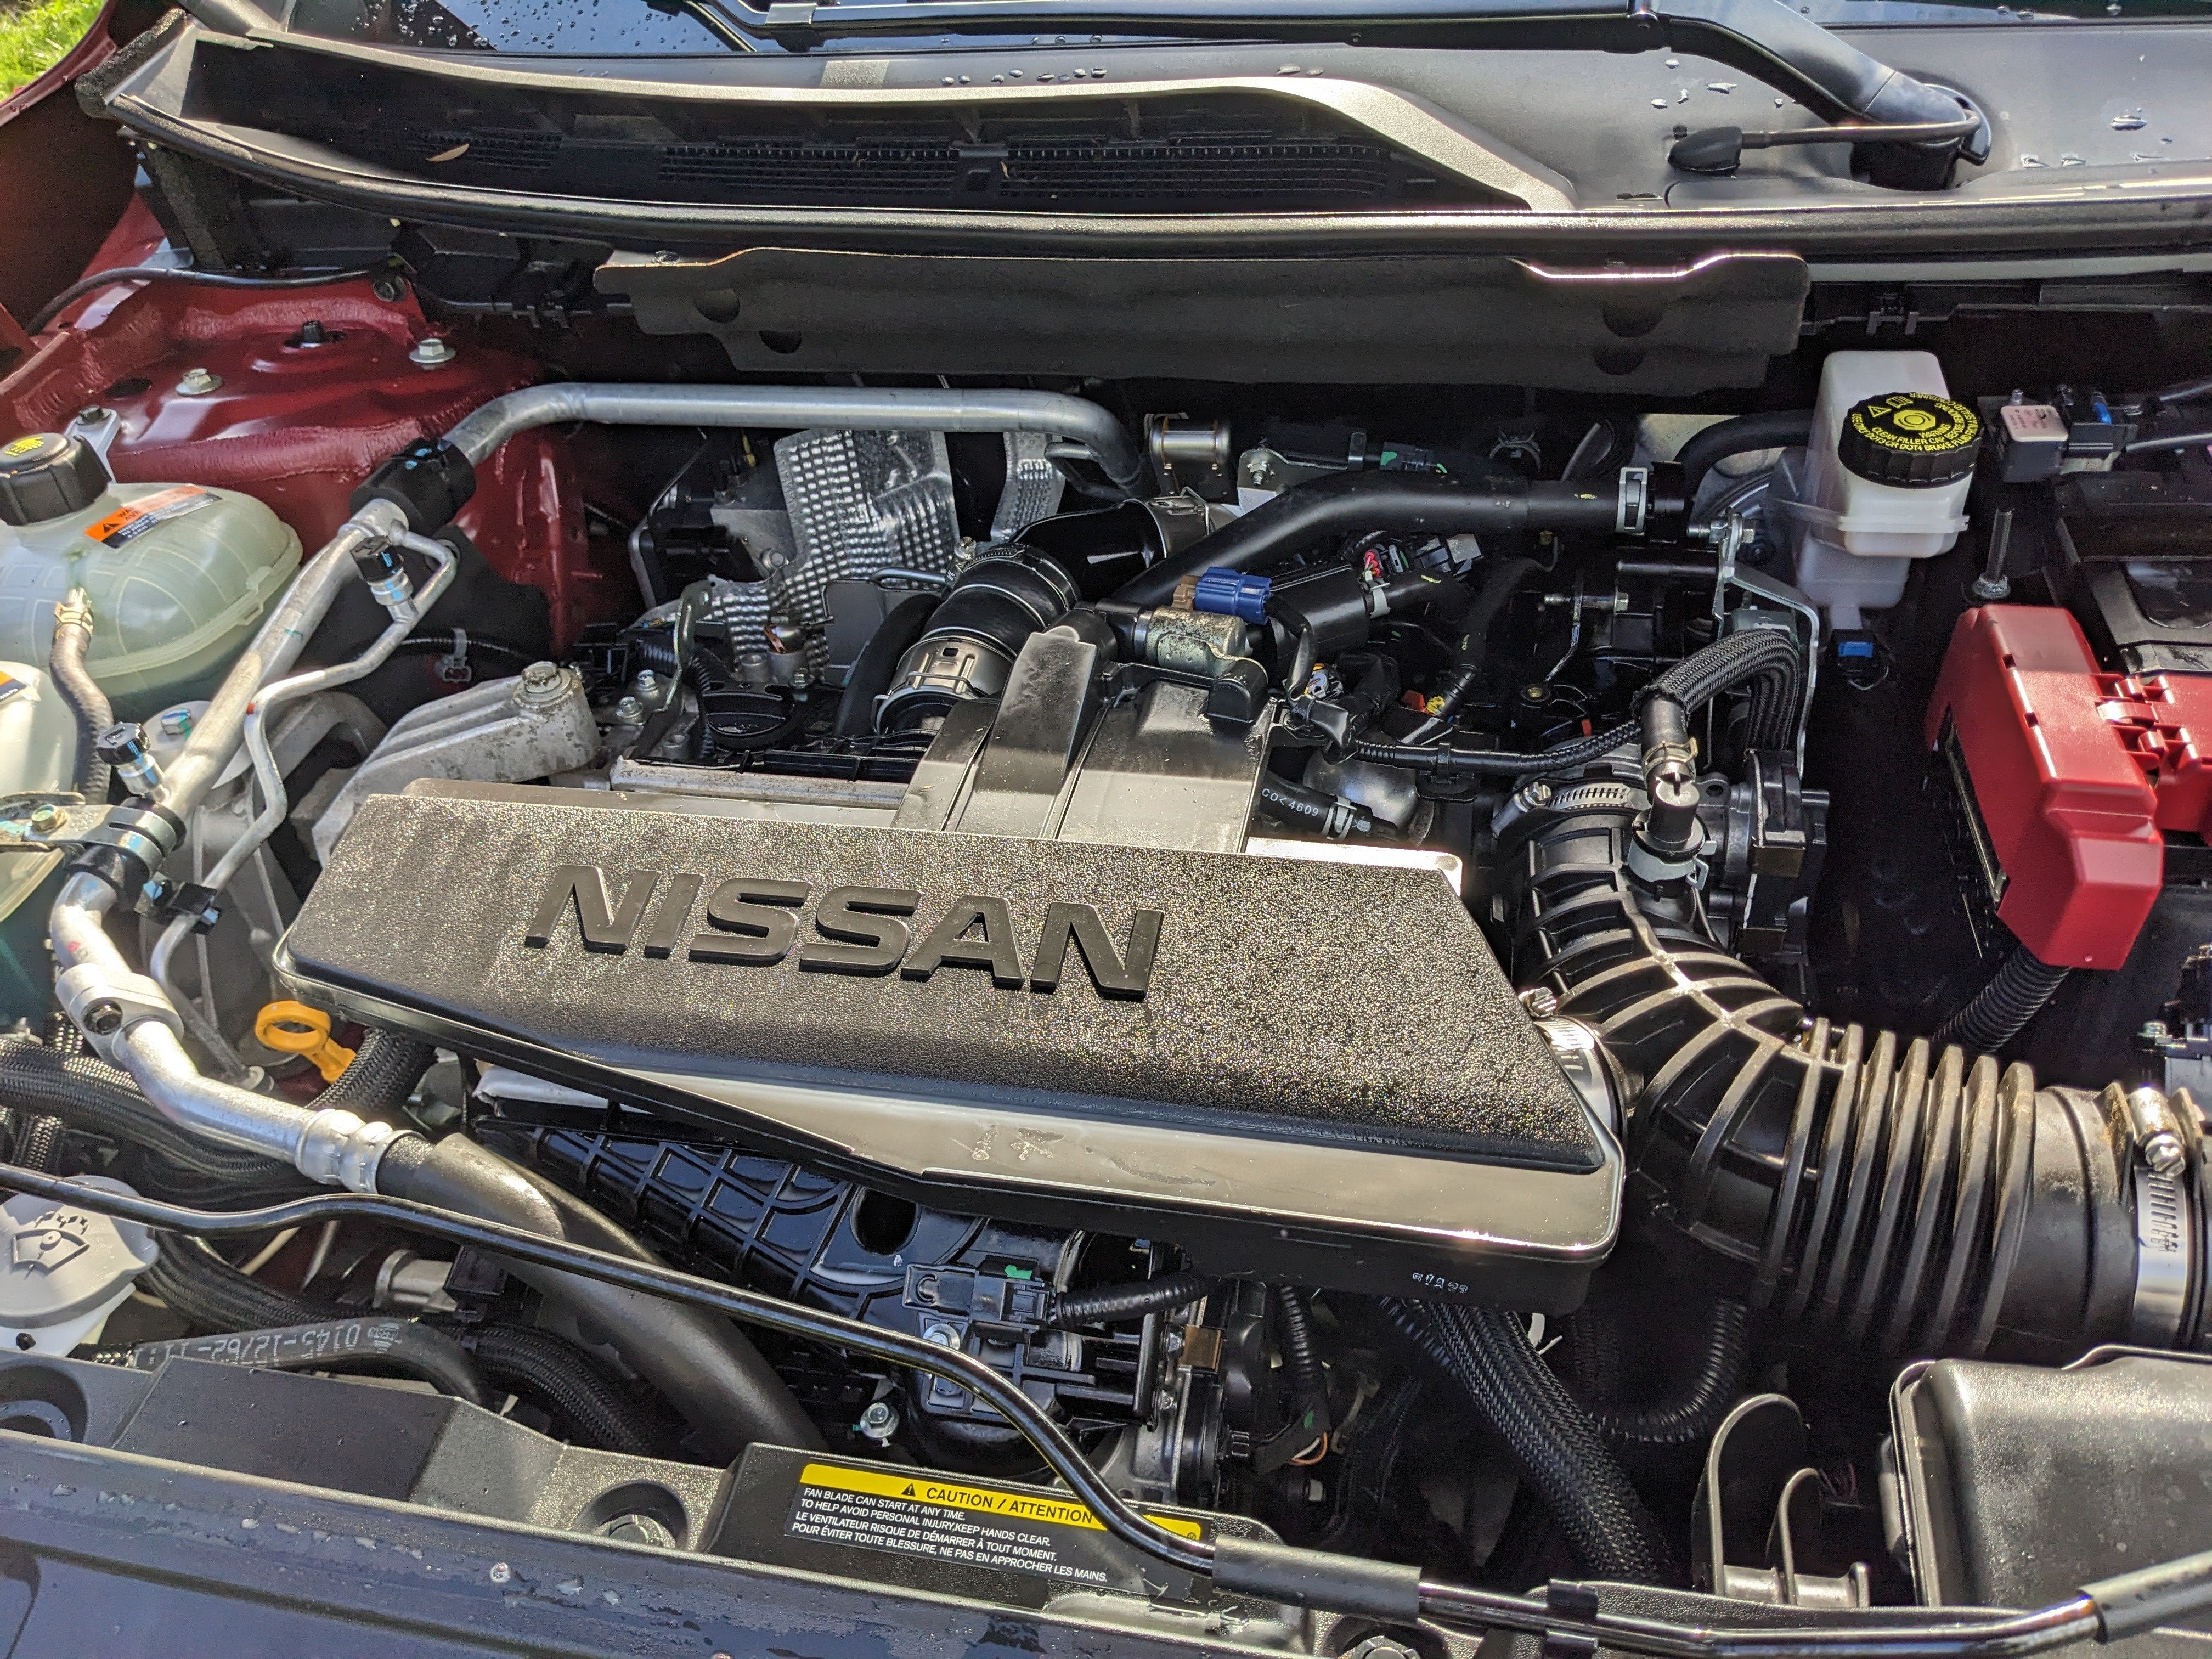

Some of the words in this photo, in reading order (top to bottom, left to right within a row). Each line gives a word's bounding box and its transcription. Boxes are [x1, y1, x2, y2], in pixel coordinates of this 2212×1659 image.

[1864, 432, 1887, 444] DOT3
[1899, 443, 1923, 452] DOT4
[1923, 441, 1955, 452] BRAKE
[1871, 427, 1898, 441] CLEAN
[1897, 437, 1928, 445] FILLER
[1928, 436, 1945, 444] CAP
[524, 863, 1166, 1000] NISSAN
[801, 1498, 814, 1508] TO
[815, 1500, 840, 1512] HELP
[841, 1504, 869, 1517] AVOID
[871, 1510, 921, 1526] PERSONAL
[981, 1527, 1016, 1541] HANDS
[1017, 1533, 1051, 1547] CLEAR.
[804, 1487, 822, 1498] FAN
[824, 1491, 855, 1503] BLADE
[856, 1496, 877, 1506] CAN
[878, 1499, 908, 1511] START
[907, 1503, 922, 1513] AT
[921, 1506, 940, 1517] ANY
[943, 1509, 966, 1521] TIME.
[927, 1487, 994, 1509] CAUTION
[997, 1498, 1007, 1510] /
[1008, 1500, 1093, 1525] ATTENTION
[792, 1522, 819, 1535] POUR
[820, 1525, 852, 1541] ÉVITER
[854, 1532, 884, 1545] TOUTE
[885, 1536, 937, 1555] BLESSURE,
[939, 1546, 953, 1557] NE
[955, 1549, 974, 1560] PAS
[975, 1551, 991, 1562] EN
[990, 1555, 1053, 1575] APPROCHER
[1054, 1565, 1073, 1577] LES
[1074, 1568, 1108, 1582] MAINS.
[795, 1510, 809, 1520] LE
[810, 1513, 870, 1531] VENTILATEUR
[870, 1522, 905, 1537] RISQUE
[907, 1528, 921, 1539] DE
[922, 1530, 975, 1548] DÉMARRER
[976, 1537, 985, 1549] À
[986, 1541, 1012, 1554] TOUT
[1012, 1545, 1057, 1561] MOMENT.
